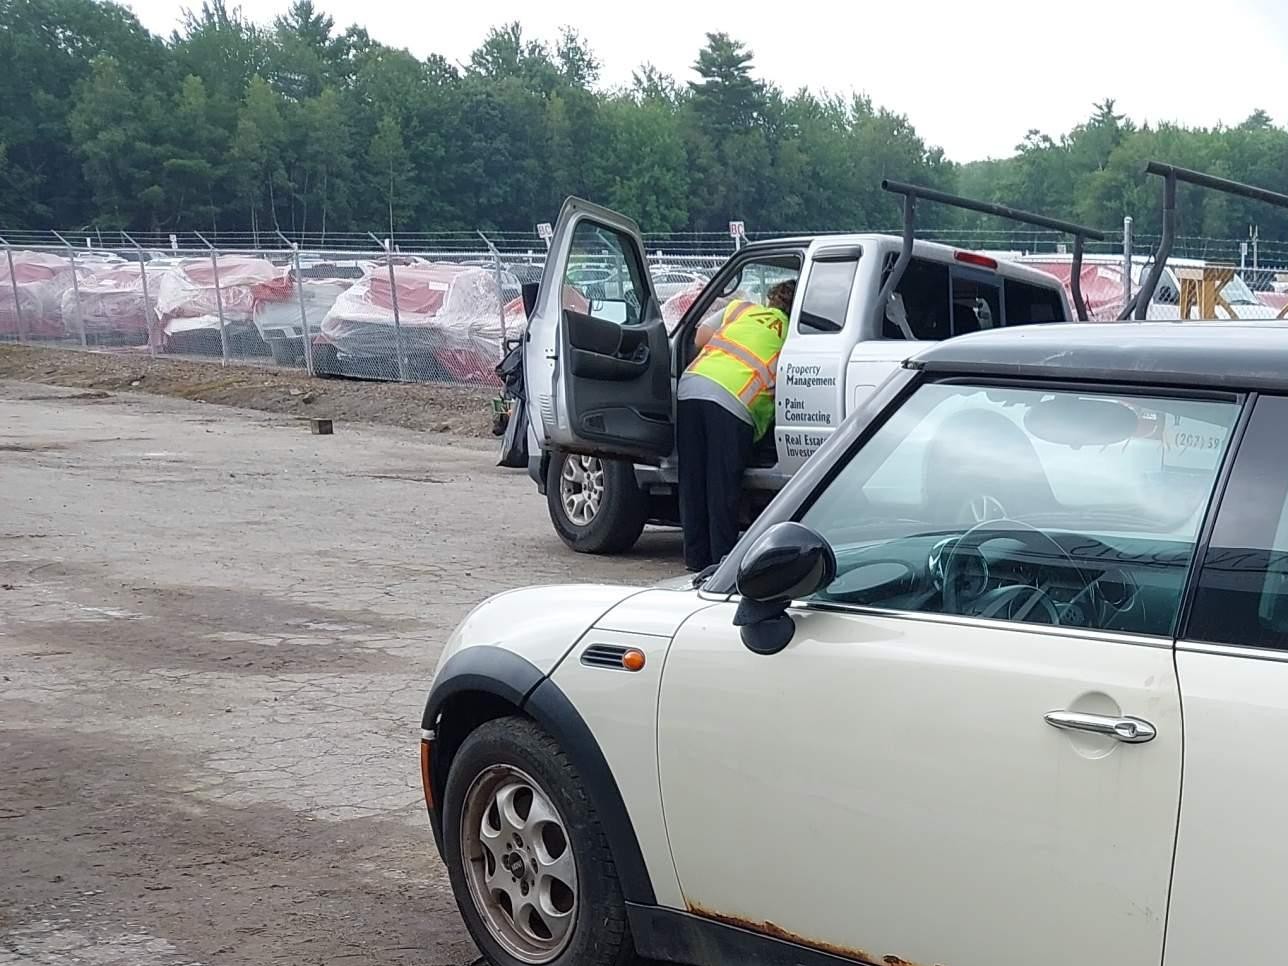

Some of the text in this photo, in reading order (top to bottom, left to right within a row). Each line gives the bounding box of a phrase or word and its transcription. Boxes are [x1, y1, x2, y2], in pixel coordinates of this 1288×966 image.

[731, 223, 744, 235] BC
[786, 363, 821, 377] Property
[786, 374, 836, 388] Management
[785, 398, 805, 409] Paint
[784, 410, 831, 424] Contracting
[785, 434, 801, 446] Real
